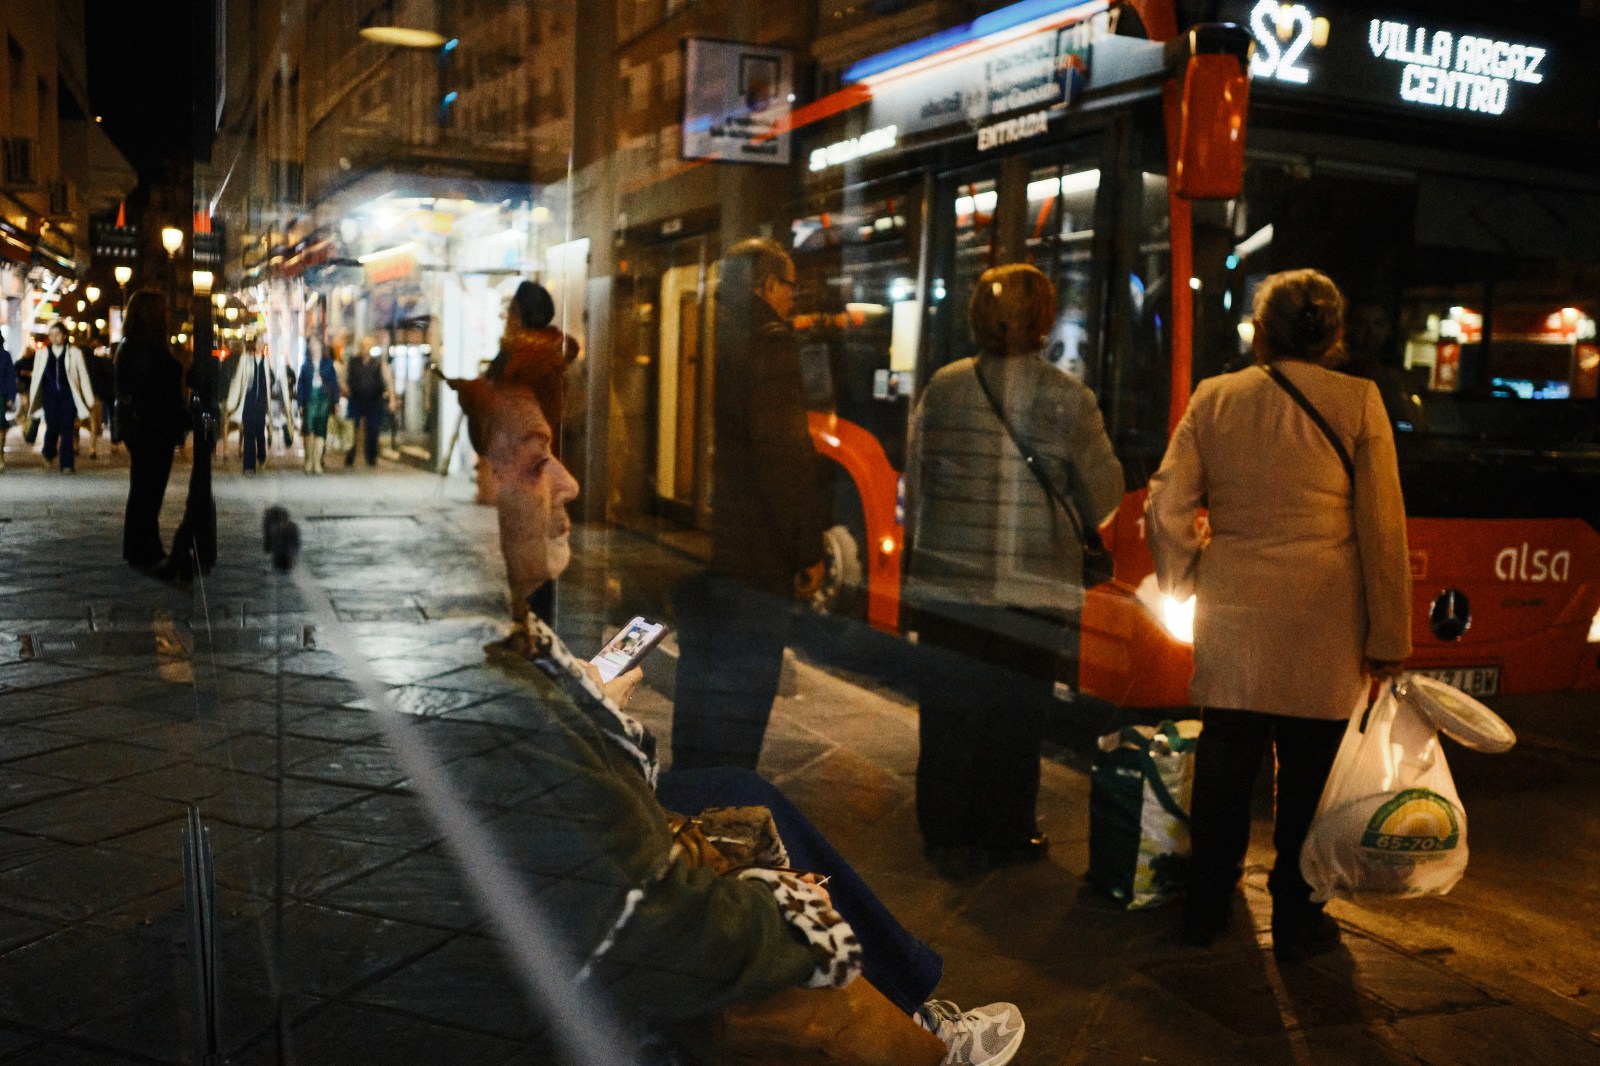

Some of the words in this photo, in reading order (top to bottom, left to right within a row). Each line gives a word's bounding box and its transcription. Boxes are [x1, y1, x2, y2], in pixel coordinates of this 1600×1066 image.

[1249, 0, 1312, 83] S2
[1369, 19, 1453, 69] VILLA
[1401, 63, 1508, 114] CENTRO
[1495, 542, 1570, 581] alsa
